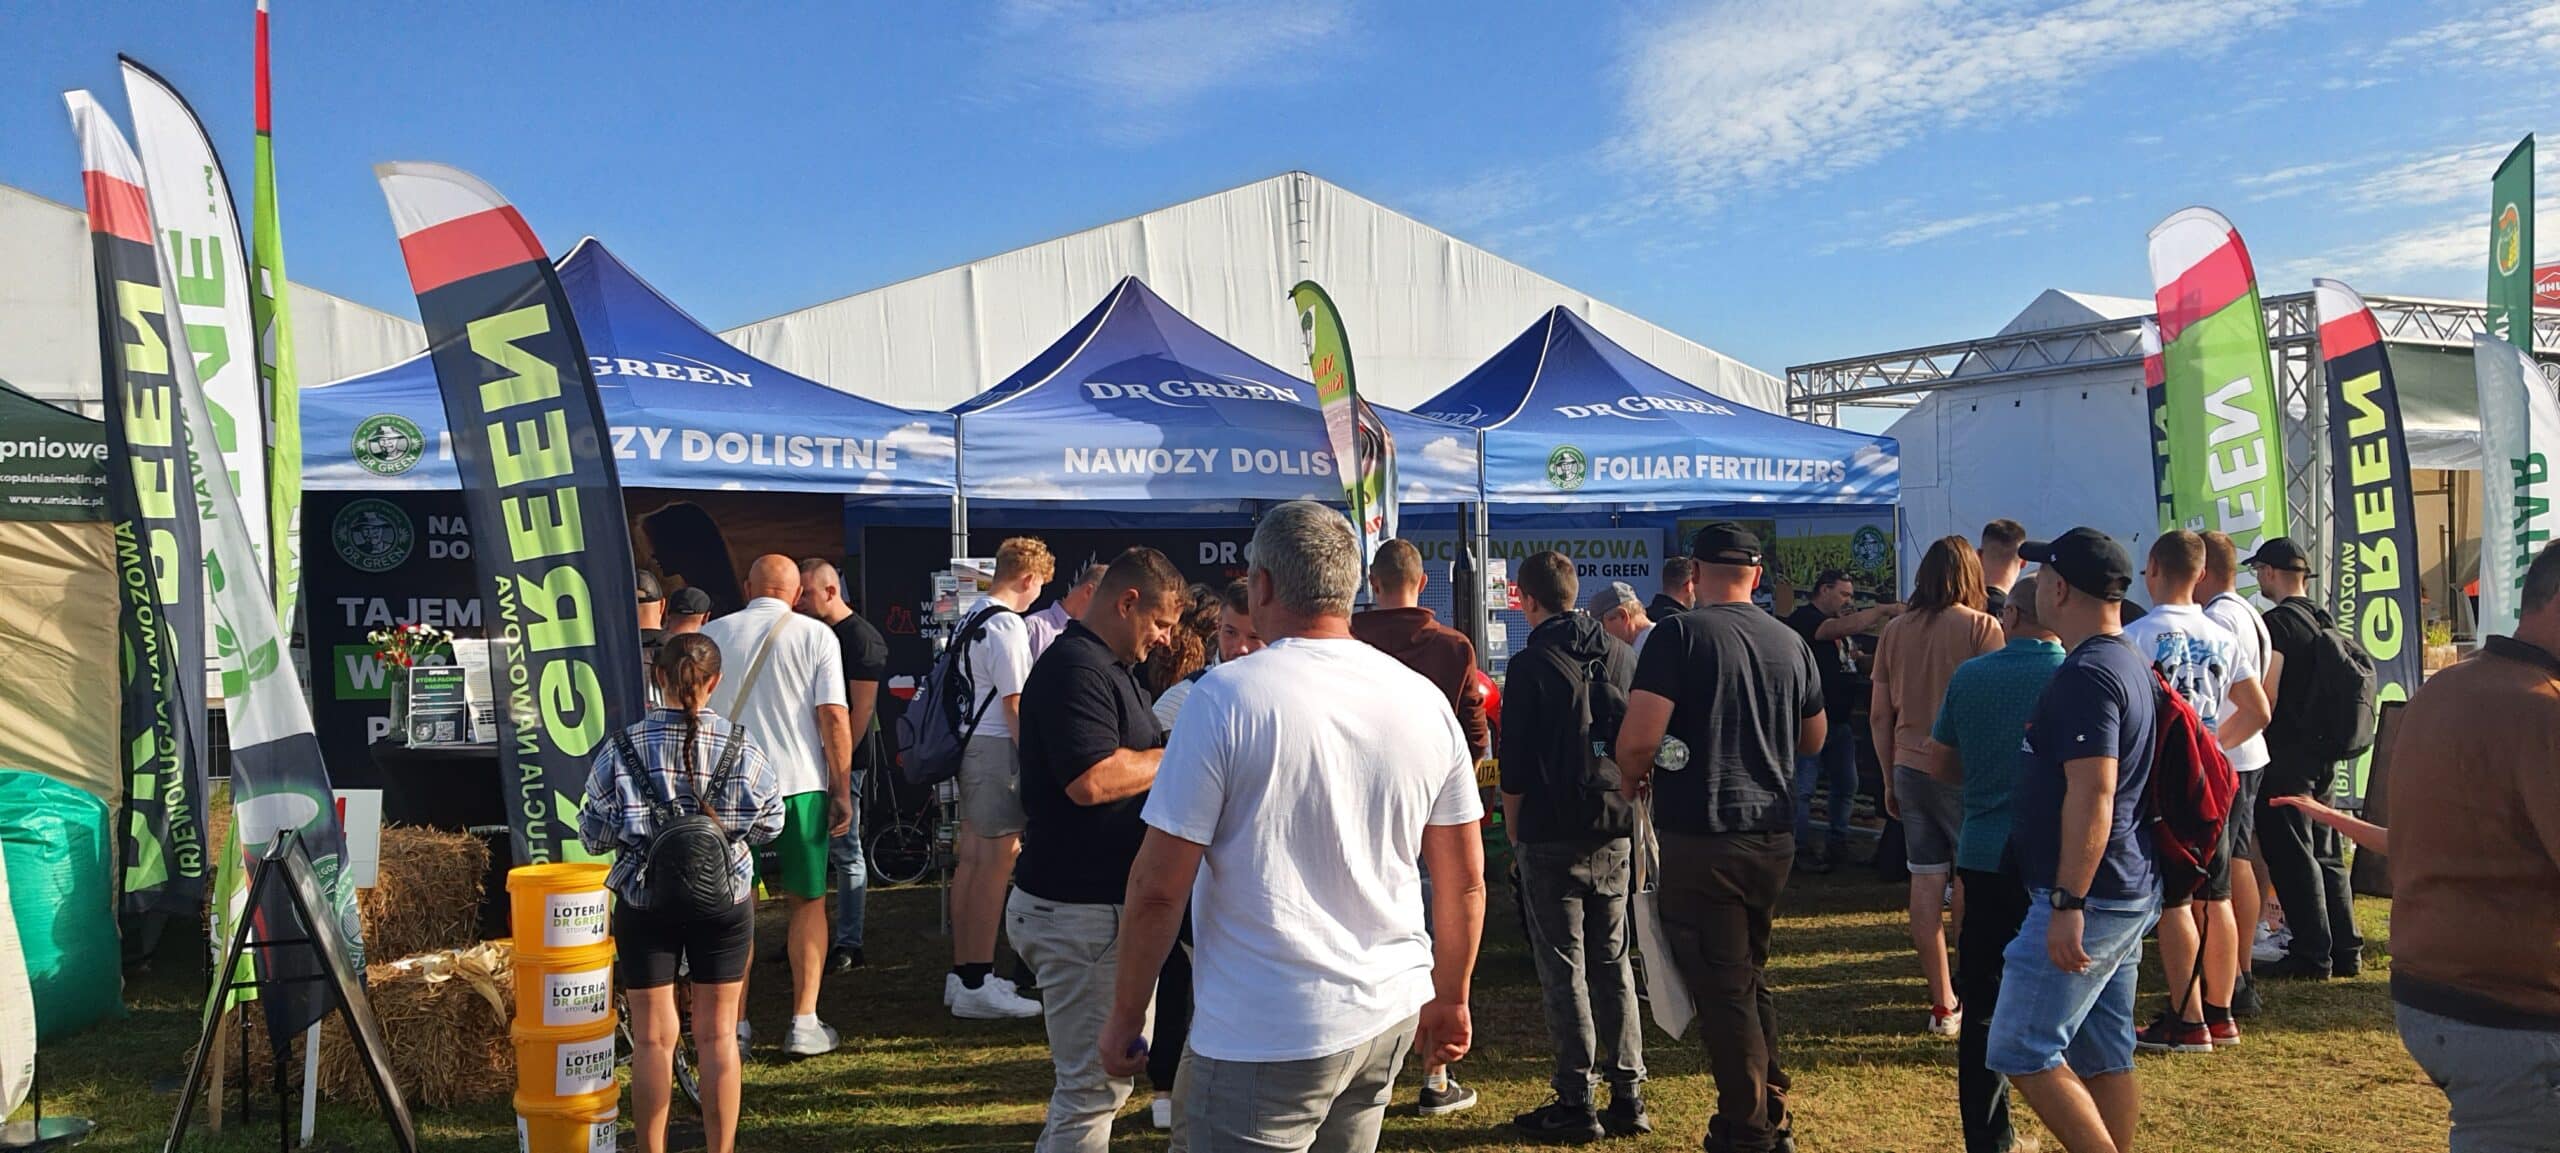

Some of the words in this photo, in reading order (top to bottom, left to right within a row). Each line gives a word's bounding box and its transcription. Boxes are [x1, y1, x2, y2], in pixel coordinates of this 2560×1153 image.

[590, 356, 753, 388] GREEN
[0, 436, 109, 463] pniowe
[682, 428, 898, 470] DOLISTNE
[378, 454, 417, 472] GREEN
[1064, 447, 1220, 475] NAWOZY
[1231, 448, 1338, 476] DOLIS
[1593, 455, 1690, 481] FOLIAR
[1696, 456, 1846, 484] FERTILIZERS
[1602, 564, 1650, 577] GREEN
[114, 520, 162, 692] NAWOZOWA
[554, 903, 605, 918] LOTERIA
[553, 918, 570, 928] DR
[591, 922, 604, 935] 44
[553, 982, 606, 998] LOTERIA
[553, 998, 569, 1007] DR
[573, 992, 606, 1006] GREEN
[591, 1001, 605, 1014] 44
[566, 1048, 612, 1067] LOTERIA
[601, 1067, 612, 1080] 44
